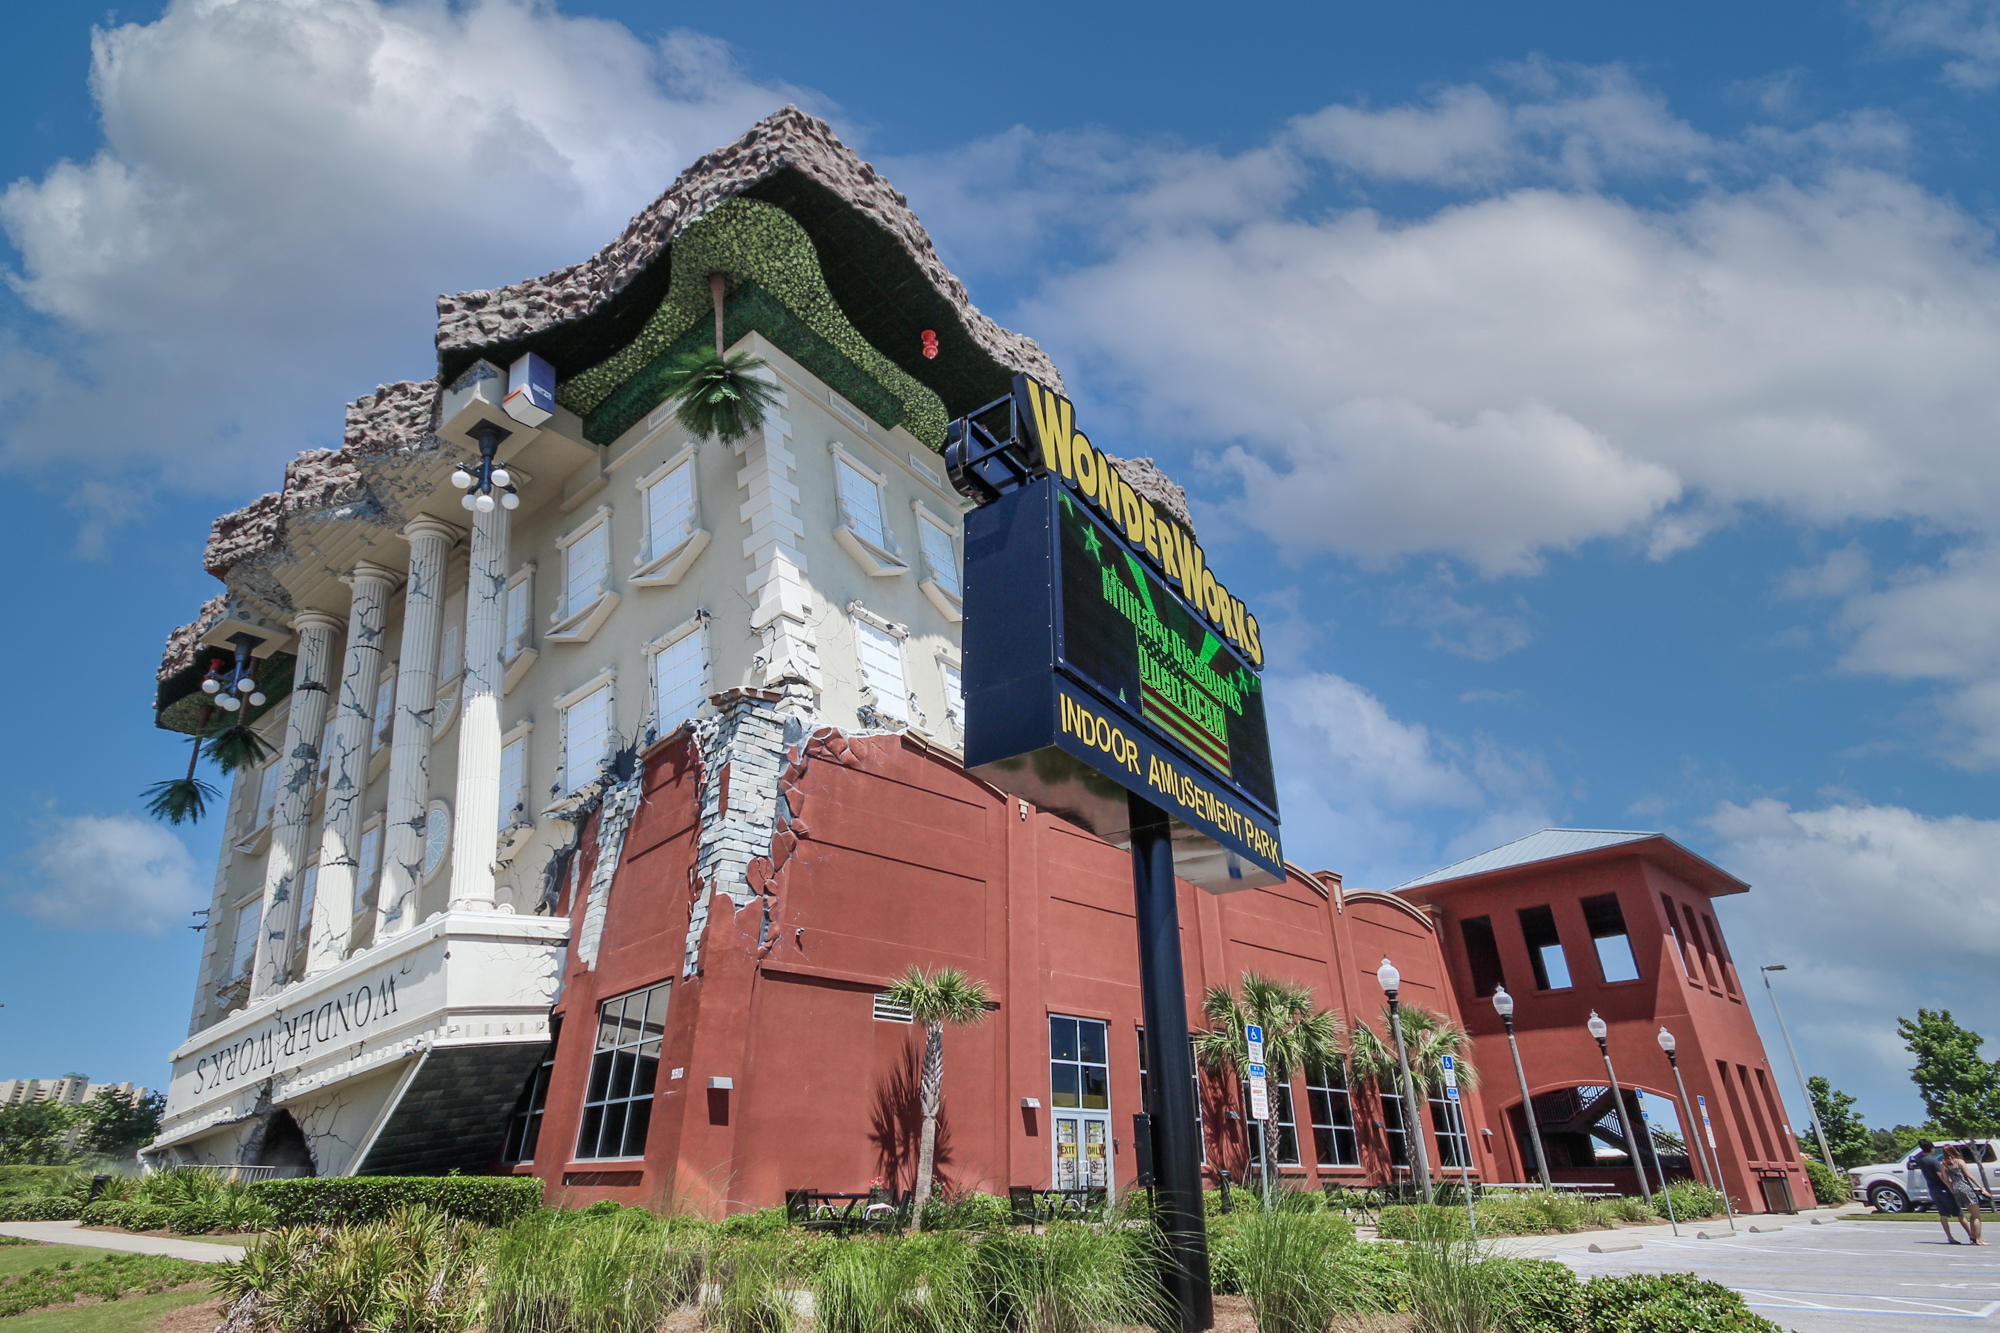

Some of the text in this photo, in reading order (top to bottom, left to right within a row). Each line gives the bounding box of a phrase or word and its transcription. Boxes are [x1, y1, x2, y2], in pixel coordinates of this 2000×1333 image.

[1026, 378, 1262, 666] WONDERWORKS
[1102, 566, 1243, 716] Military Discounts
[1138, 645, 1183, 708] Open
[1060, 692, 1281, 868] INDOOR AMUSEMENT PARK
[1060, 1146, 1102, 1155] EXIT ONLY
